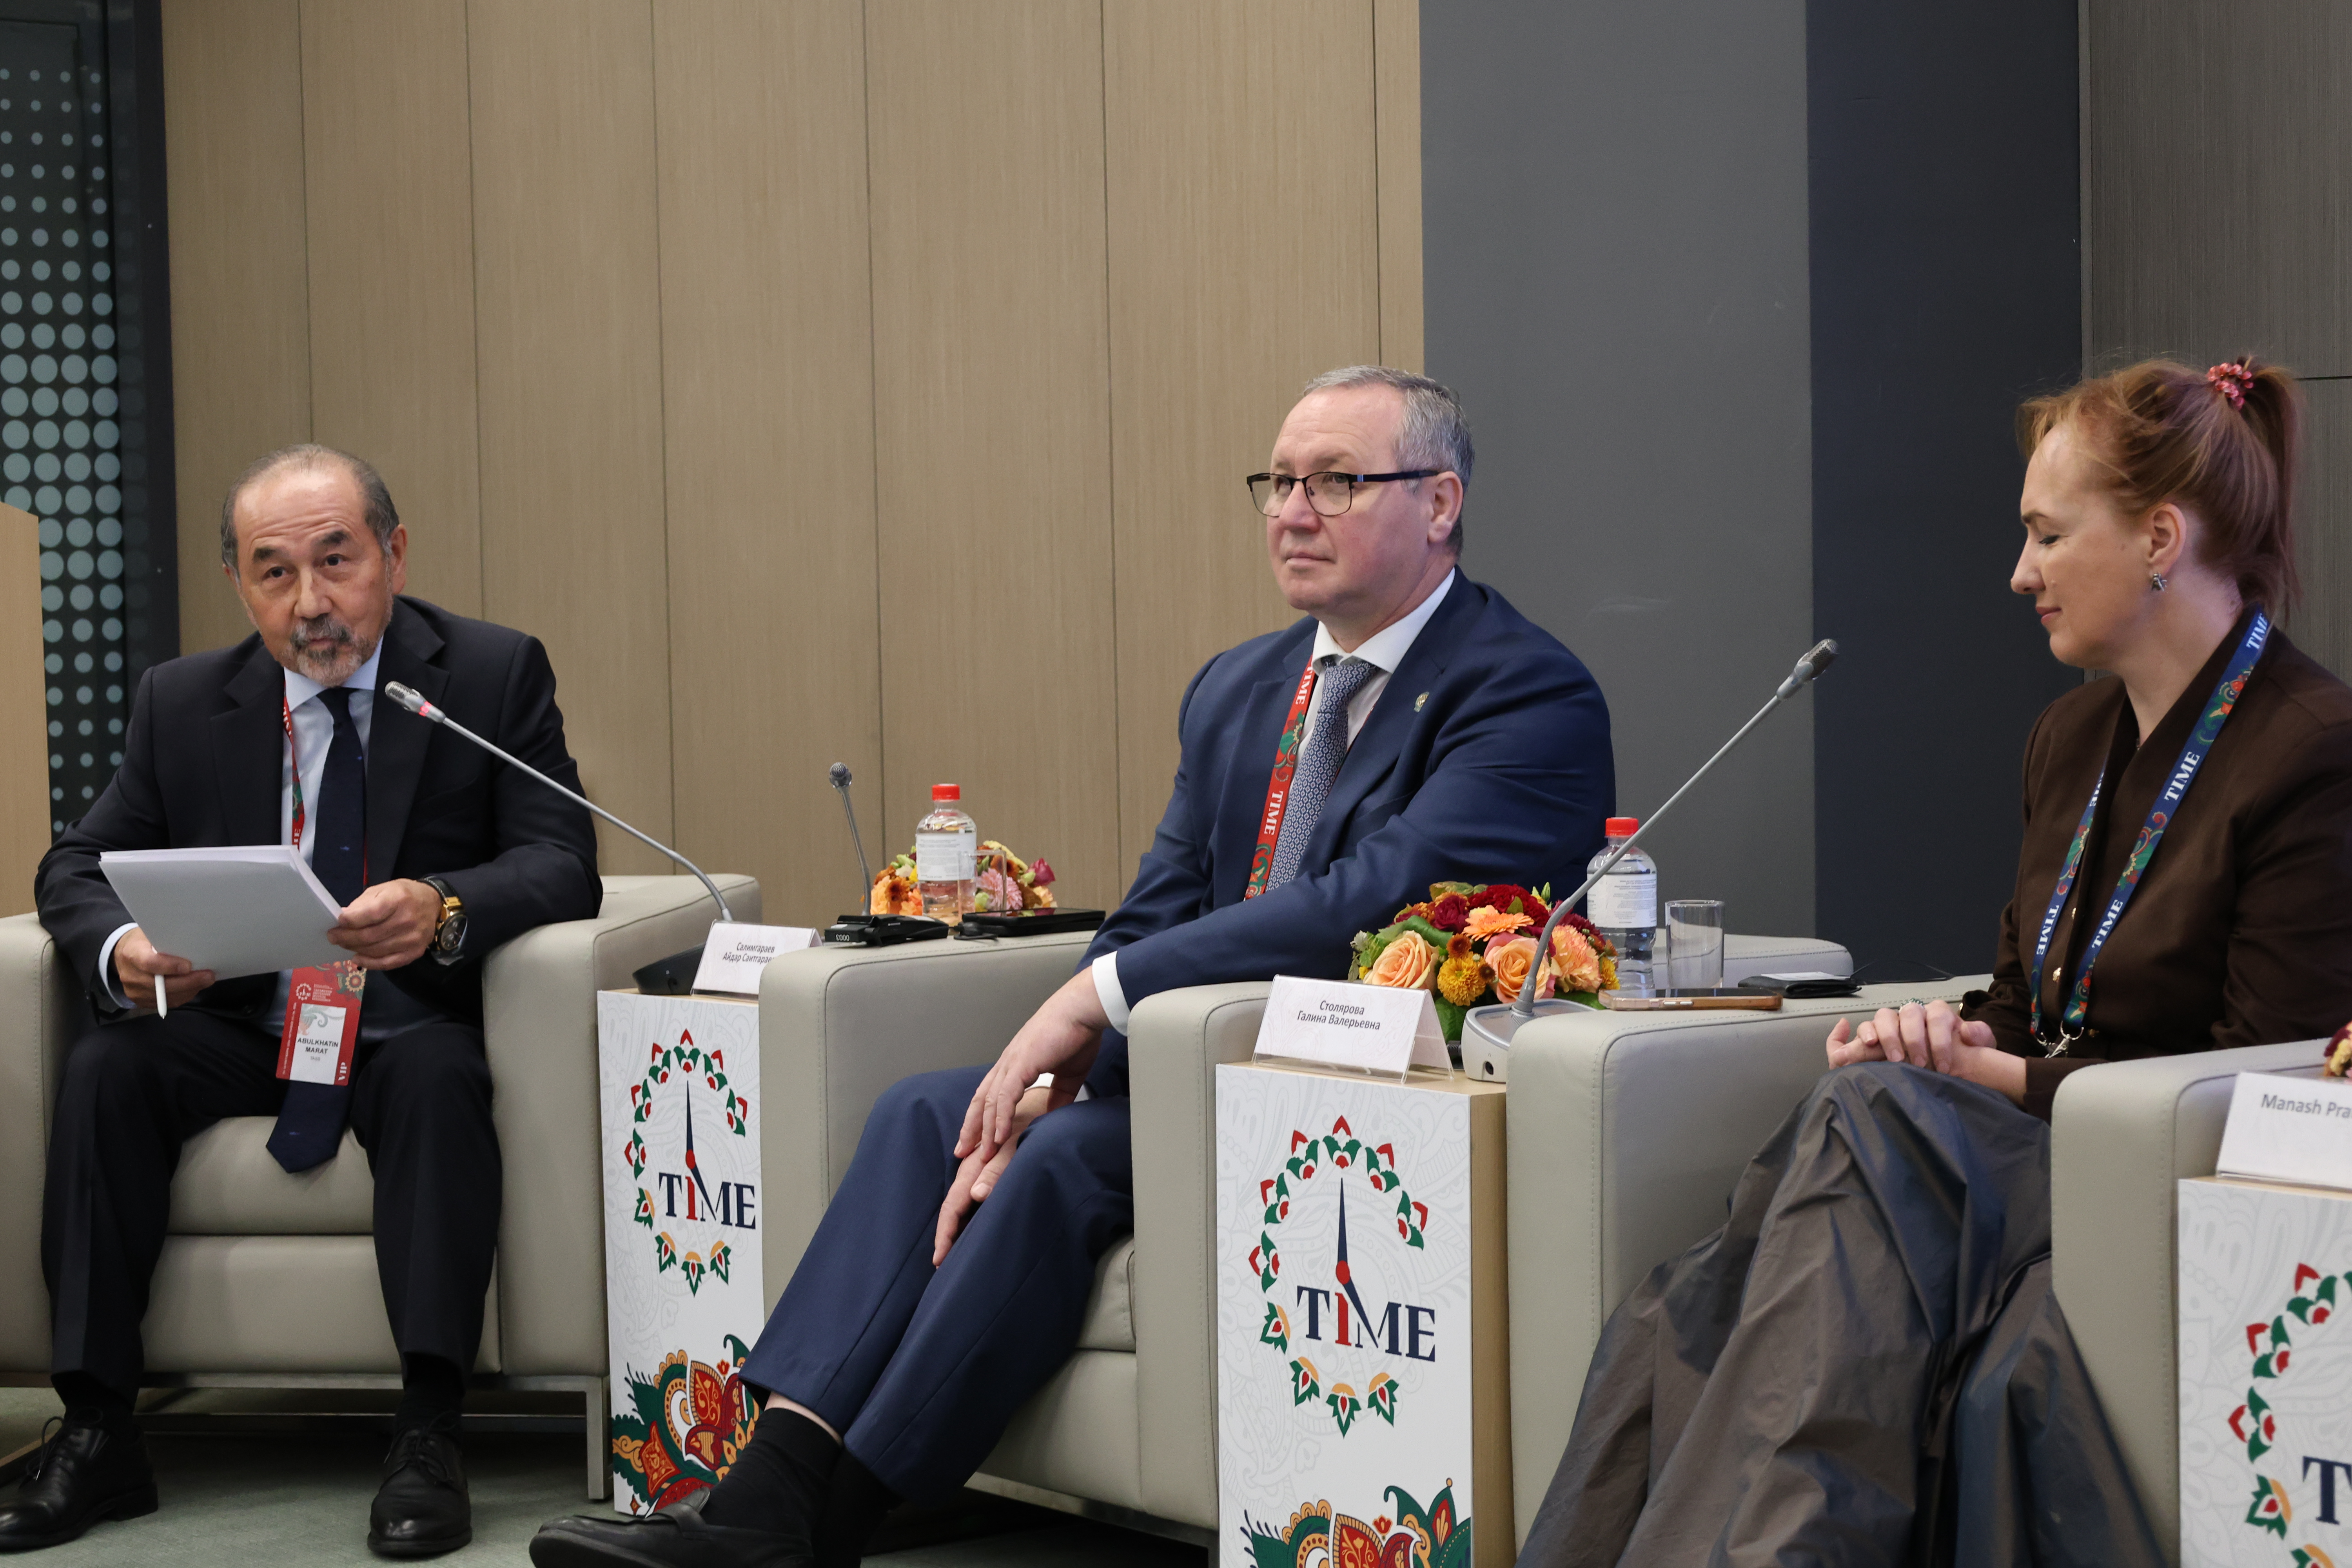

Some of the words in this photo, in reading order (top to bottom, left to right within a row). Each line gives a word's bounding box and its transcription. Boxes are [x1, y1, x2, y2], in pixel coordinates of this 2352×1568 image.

[1295, 666, 1313, 705] TIME
[2164, 751, 2200, 800] TIME
[1264, 791, 1284, 835] TIME
[2036, 905, 2060, 955] TIME
[2092, 899, 2123, 948] TIME
[722, 952, 741, 963] Айдар
[742, 953, 774, 965] Саитгарае
[737, 942, 775, 954] Салимгараев
[1297, 1010, 1327, 1023] Галина
[1328, 1014, 1381, 1030] Валерьевна
[1320, 1000, 1365, 1015] Столярова
[298, 1037, 338, 1047] ABULKHATIN
[2261, 1094, 2321, 1115] Manash
[2325, 1102, 2352, 1118] Pra
[659, 1172, 756, 1230] TIME
[1297, 1285, 1435, 1362] TIME
